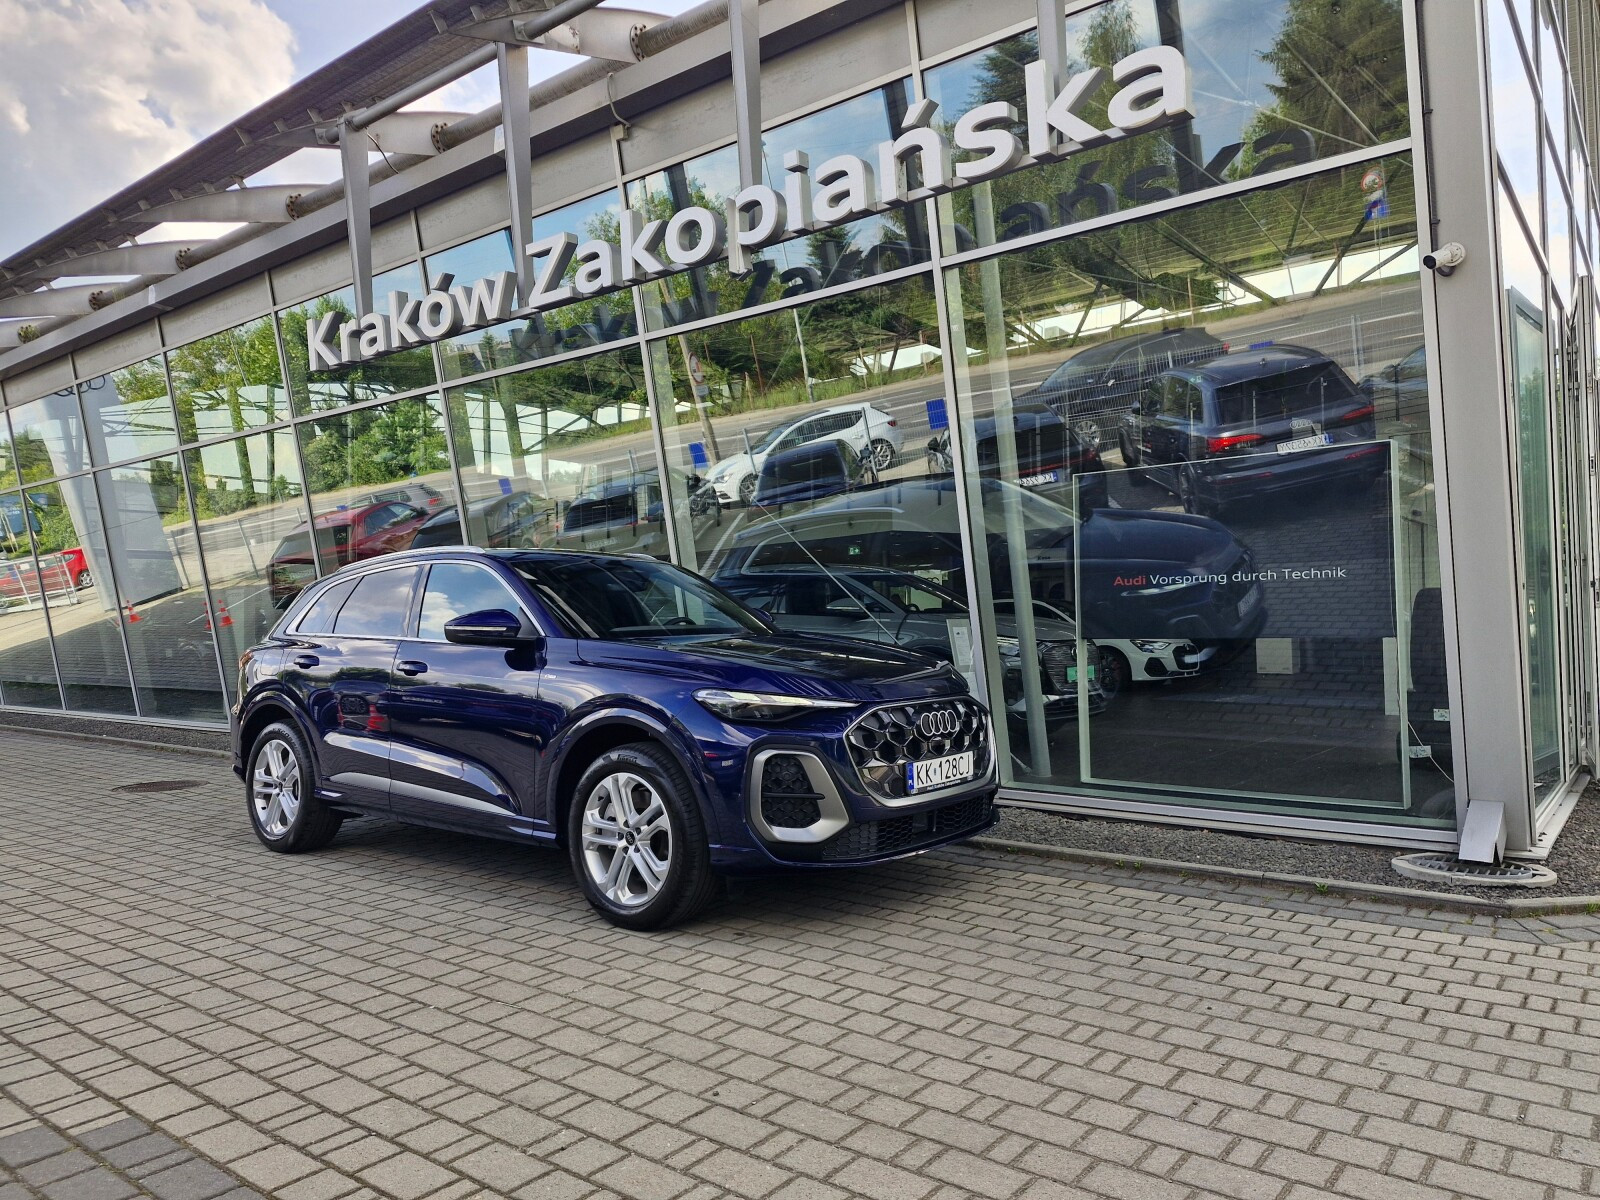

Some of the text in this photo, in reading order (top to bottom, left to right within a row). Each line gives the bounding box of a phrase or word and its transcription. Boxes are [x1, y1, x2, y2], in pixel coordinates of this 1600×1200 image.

[306, 45, 1193, 371] Kraków Zakopiańska
[1113, 566, 1347, 588] Audi Vorsprung durch Technik
[916, 762, 933, 786] KK
[938, 754, 970, 781] 128CJ
